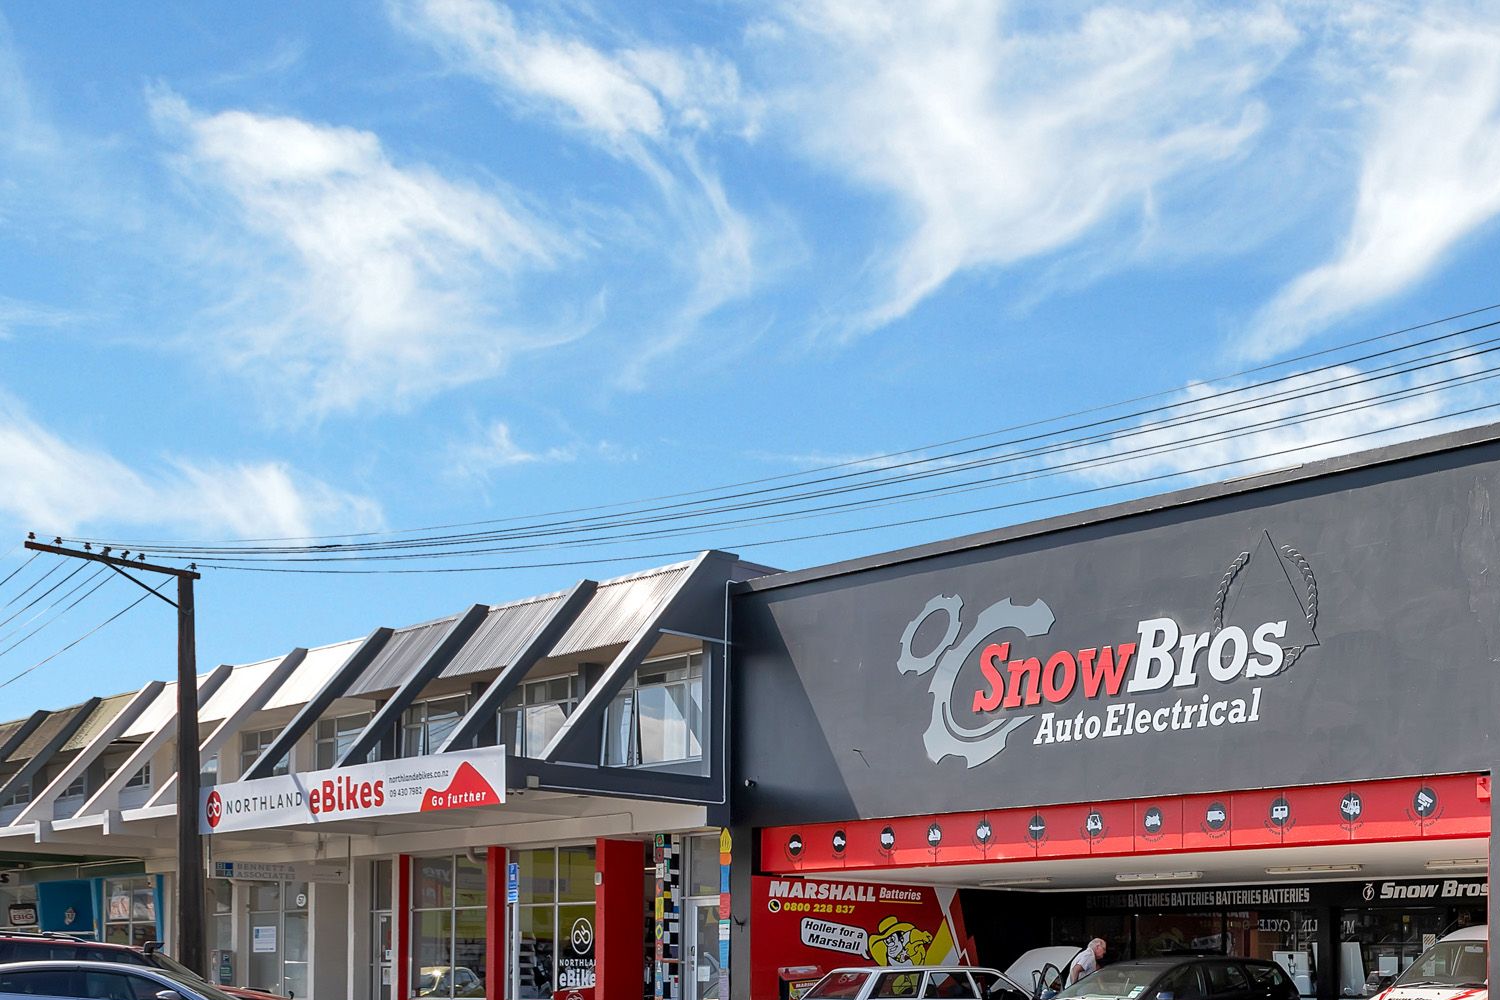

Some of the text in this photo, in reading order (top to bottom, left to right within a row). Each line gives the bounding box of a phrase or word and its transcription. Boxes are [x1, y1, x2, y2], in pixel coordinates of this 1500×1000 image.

[388, 769, 449, 784] northlandebikes.co.nz
[226, 775, 384, 815] NORTHLAND eBikes
[389, 788, 397, 798] 09
[397, 788, 408, 797] 430
[431, 791, 487, 807] Go further
[768, 880, 922, 902] MARSHALL Batteries
[1127, 893, 1170, 908] BATTERIES
[1171, 891, 1215, 906] BATTERIES
[1215, 889, 1261, 905] BATTERIES
[1262, 887, 1310, 903] BATTERIES
[1379, 879, 1489, 899] Snow Bros
[783, 902, 856, 914] 0800 228 837
[804, 920, 864, 939] Holler for a
[808, 933, 861, 952] Marshall
[559, 958, 596, 967] NORTHLA
[559, 968, 596, 987] eBike
